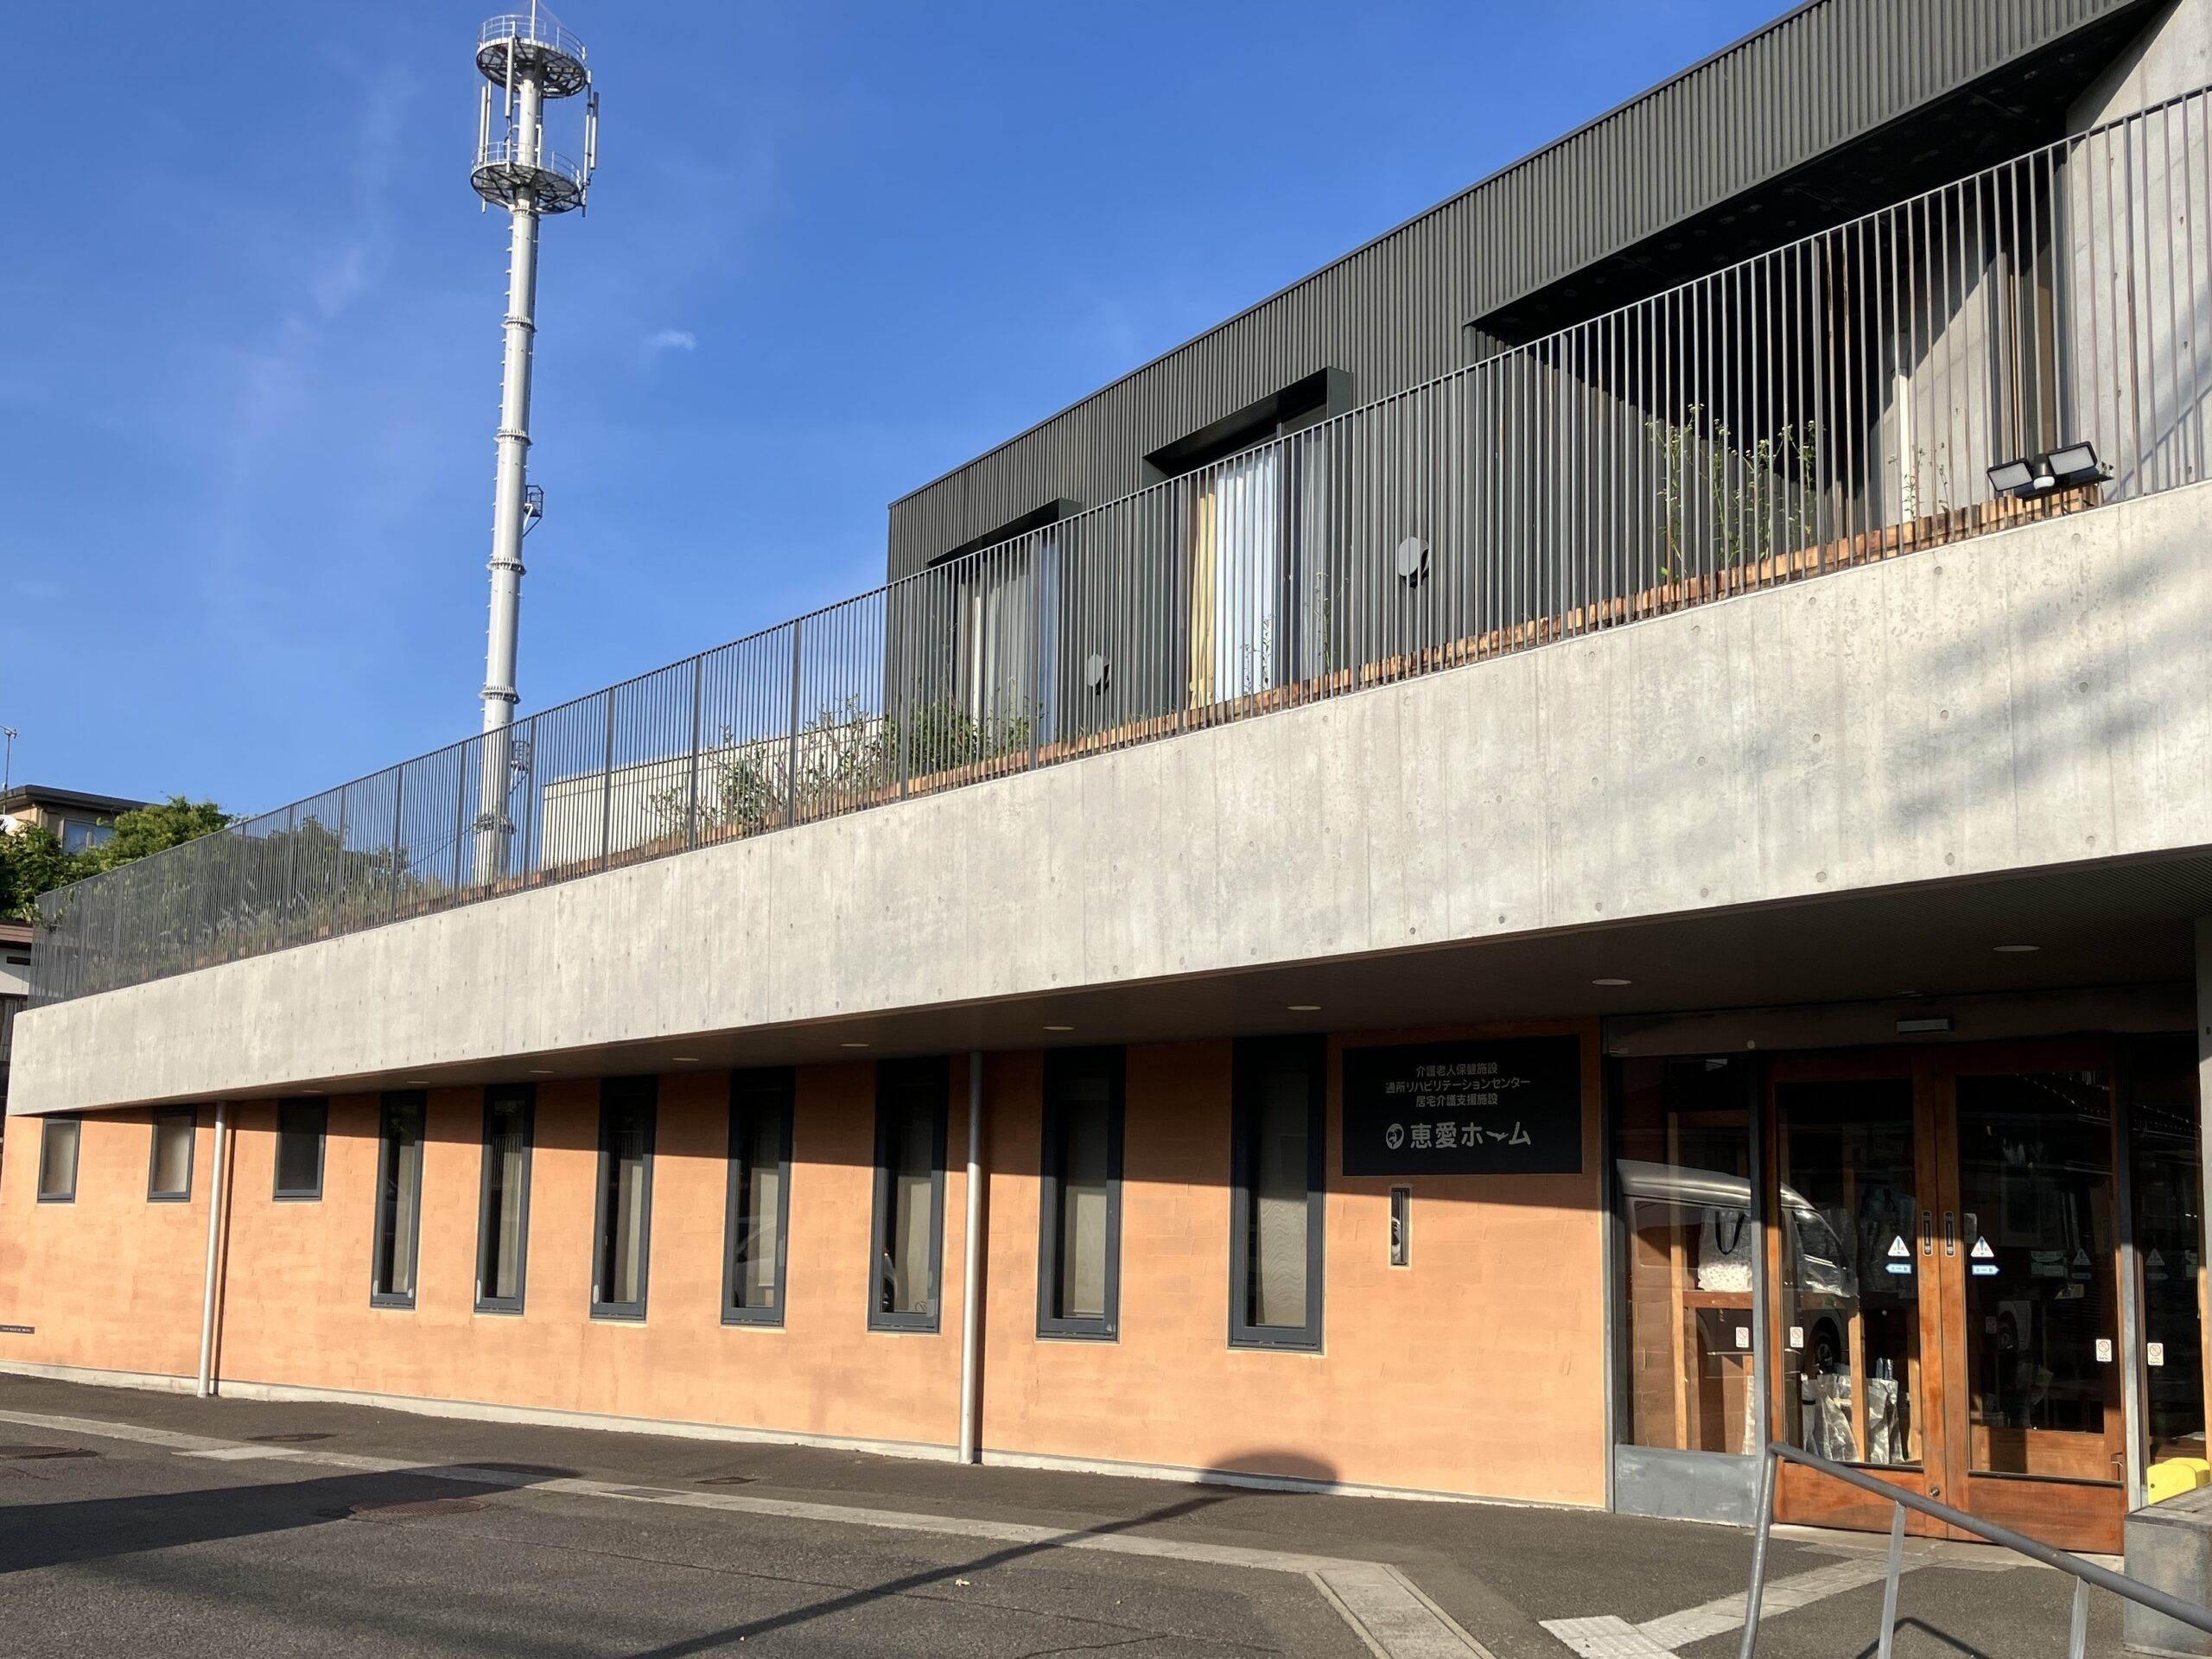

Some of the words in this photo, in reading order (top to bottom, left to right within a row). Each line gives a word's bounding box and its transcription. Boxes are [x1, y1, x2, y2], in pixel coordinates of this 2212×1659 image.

[1415, 1062, 1497, 1077] 介護老人保健施設
[1385, 1077, 1531, 1094] 通所リハビリテーションセンター
[1415, 1093, 1498, 1108] 居宅介護支援施設
[1410, 1122, 1532, 1149] 恵愛ホーム
